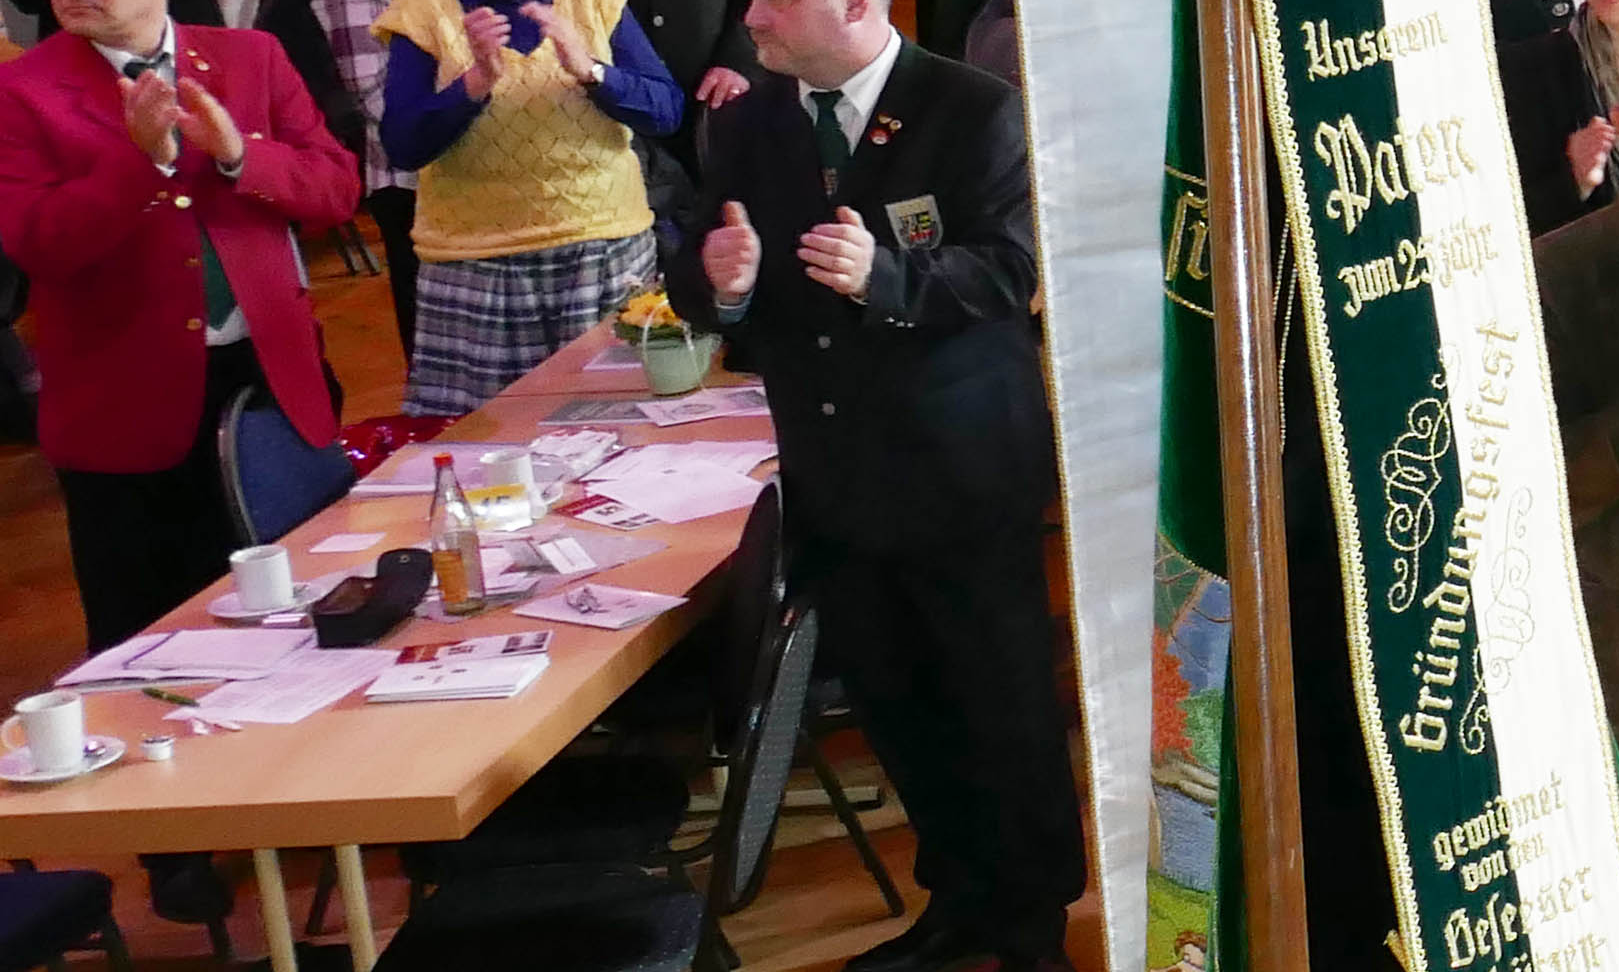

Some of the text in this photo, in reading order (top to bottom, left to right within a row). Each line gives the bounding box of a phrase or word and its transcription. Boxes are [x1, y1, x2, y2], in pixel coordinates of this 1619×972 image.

[1301, 12, 1449, 81] Unserem
[1314, 113, 1478, 234] Paten
[1337, 256, 1402, 318] zum
[1399, 318, 1519, 753] Gründungsfest
[1432, 769, 1564, 871] gewidmet
[1461, 850, 1508, 891] von
